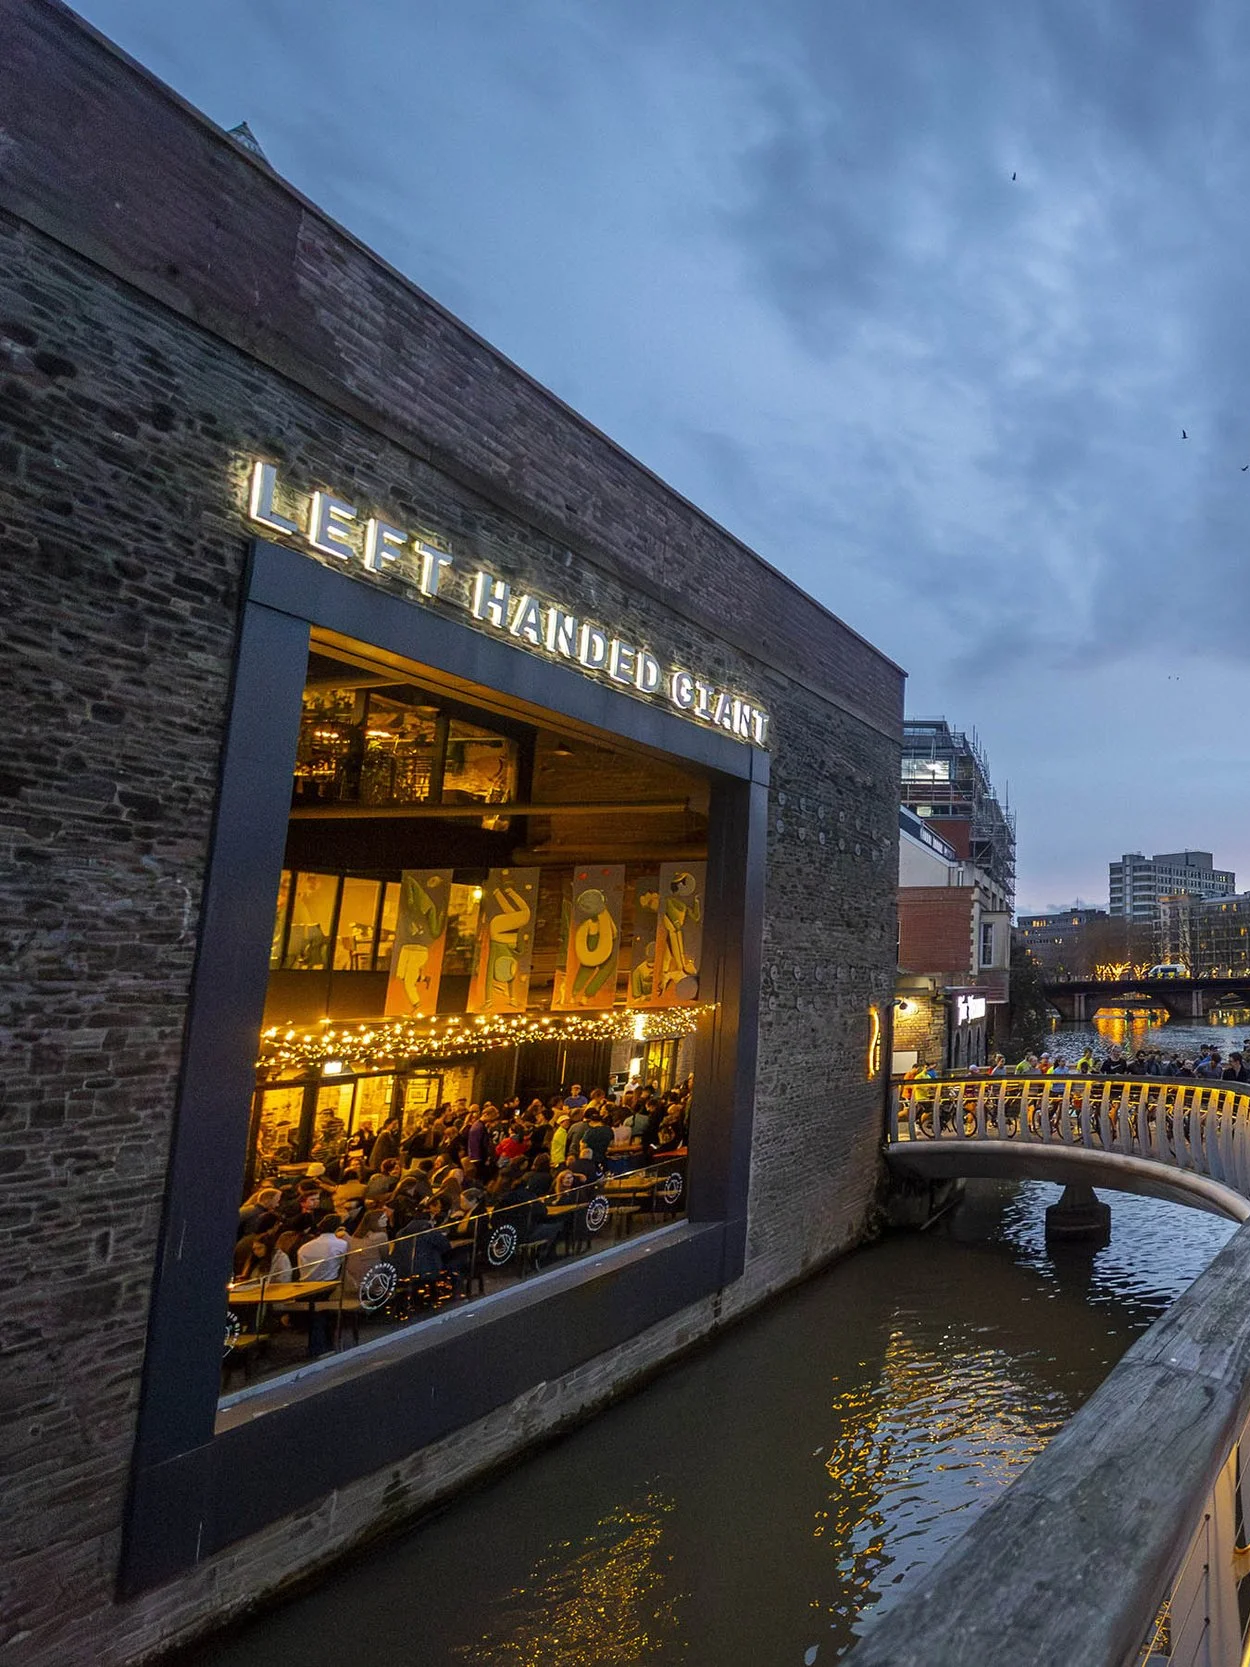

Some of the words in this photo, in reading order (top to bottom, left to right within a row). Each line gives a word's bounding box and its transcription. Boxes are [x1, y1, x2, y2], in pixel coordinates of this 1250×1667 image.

[250, 461, 453, 597] LEFT
[473, 571, 662, 694] HANDED
[671, 671, 769, 746] GIANT
